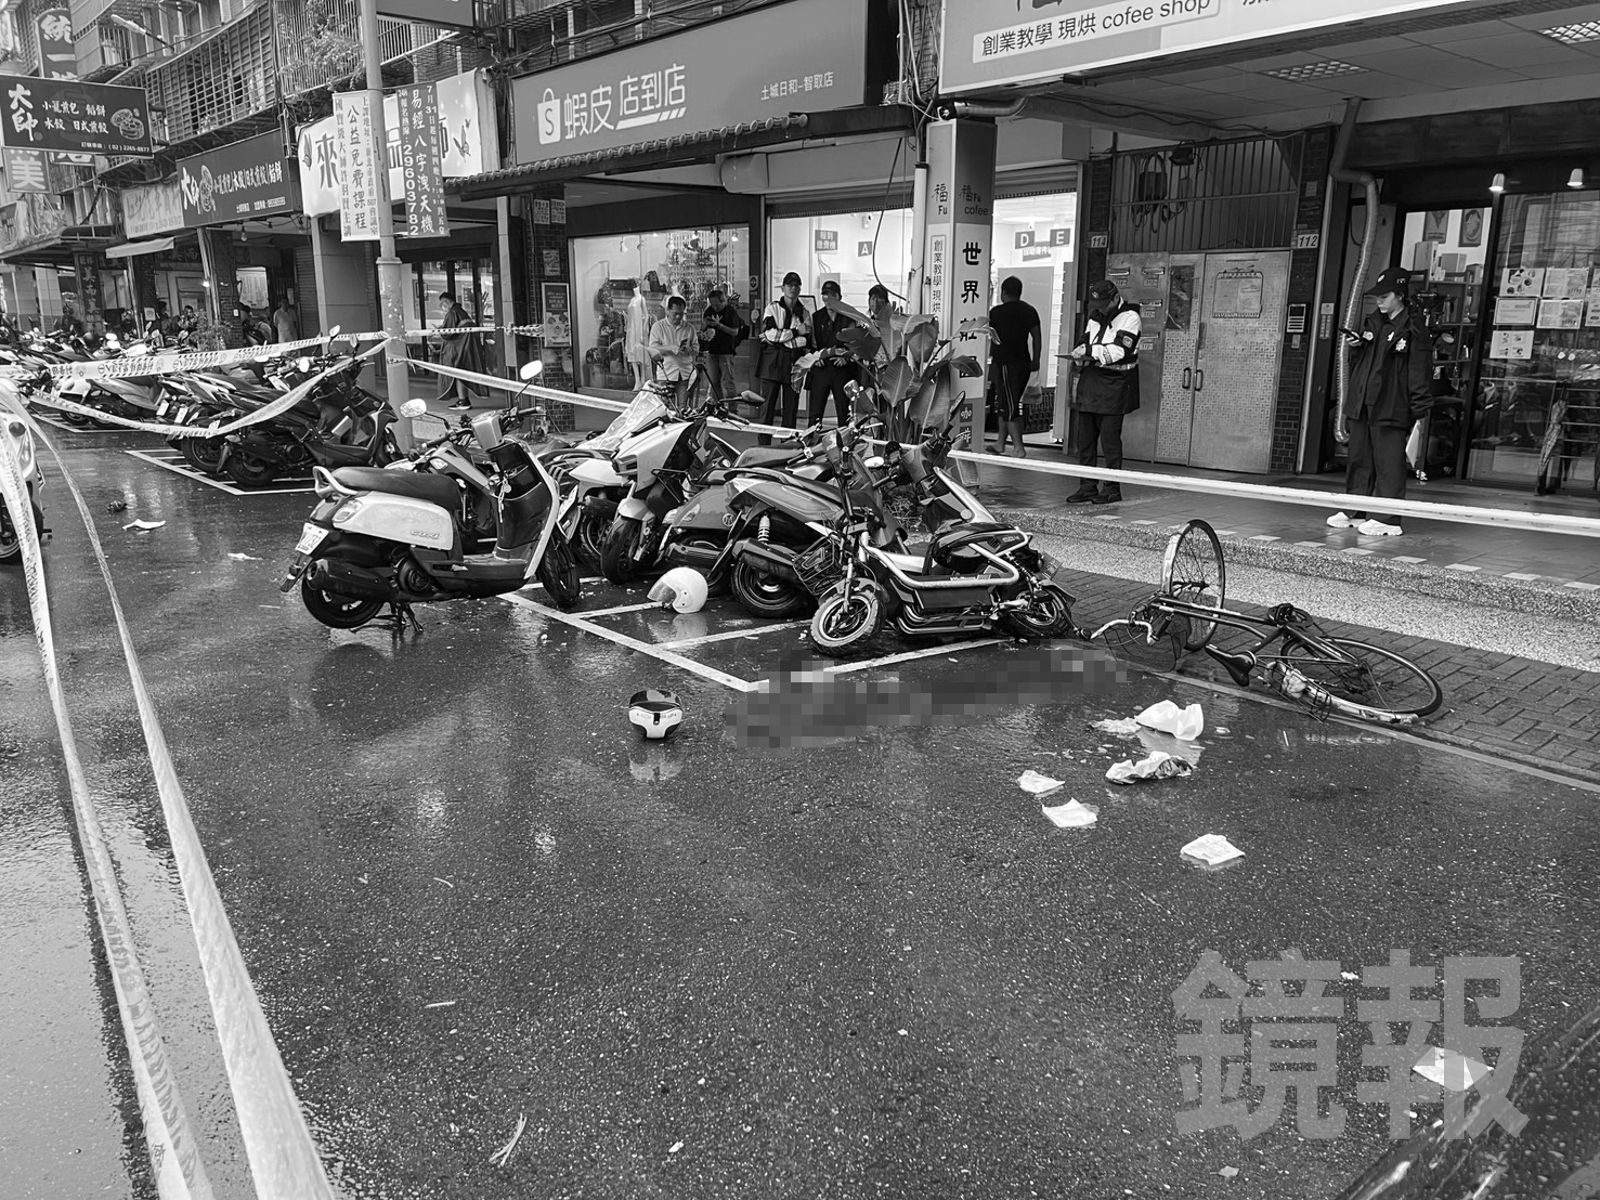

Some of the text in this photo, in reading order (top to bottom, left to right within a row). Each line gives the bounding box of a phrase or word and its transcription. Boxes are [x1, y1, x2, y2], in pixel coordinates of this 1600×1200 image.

[981, 0, 1209, 56] 創業教學 現烘 cofee shop
[8, 83, 39, 142] 大帥
[44, 117, 66, 130] 水餃
[347, 105, 367, 230] 公益免費課程
[411, 89, 435, 233] 易經八字洩天機
[932, 183, 949, 202] 福
[938, 205, 948, 215] Fu
[1020, 233, 1029, 247] D
[1056, 231, 1065, 245] E
[1299, 235, 1318, 248] 112
[860, 243, 870, 255] A
